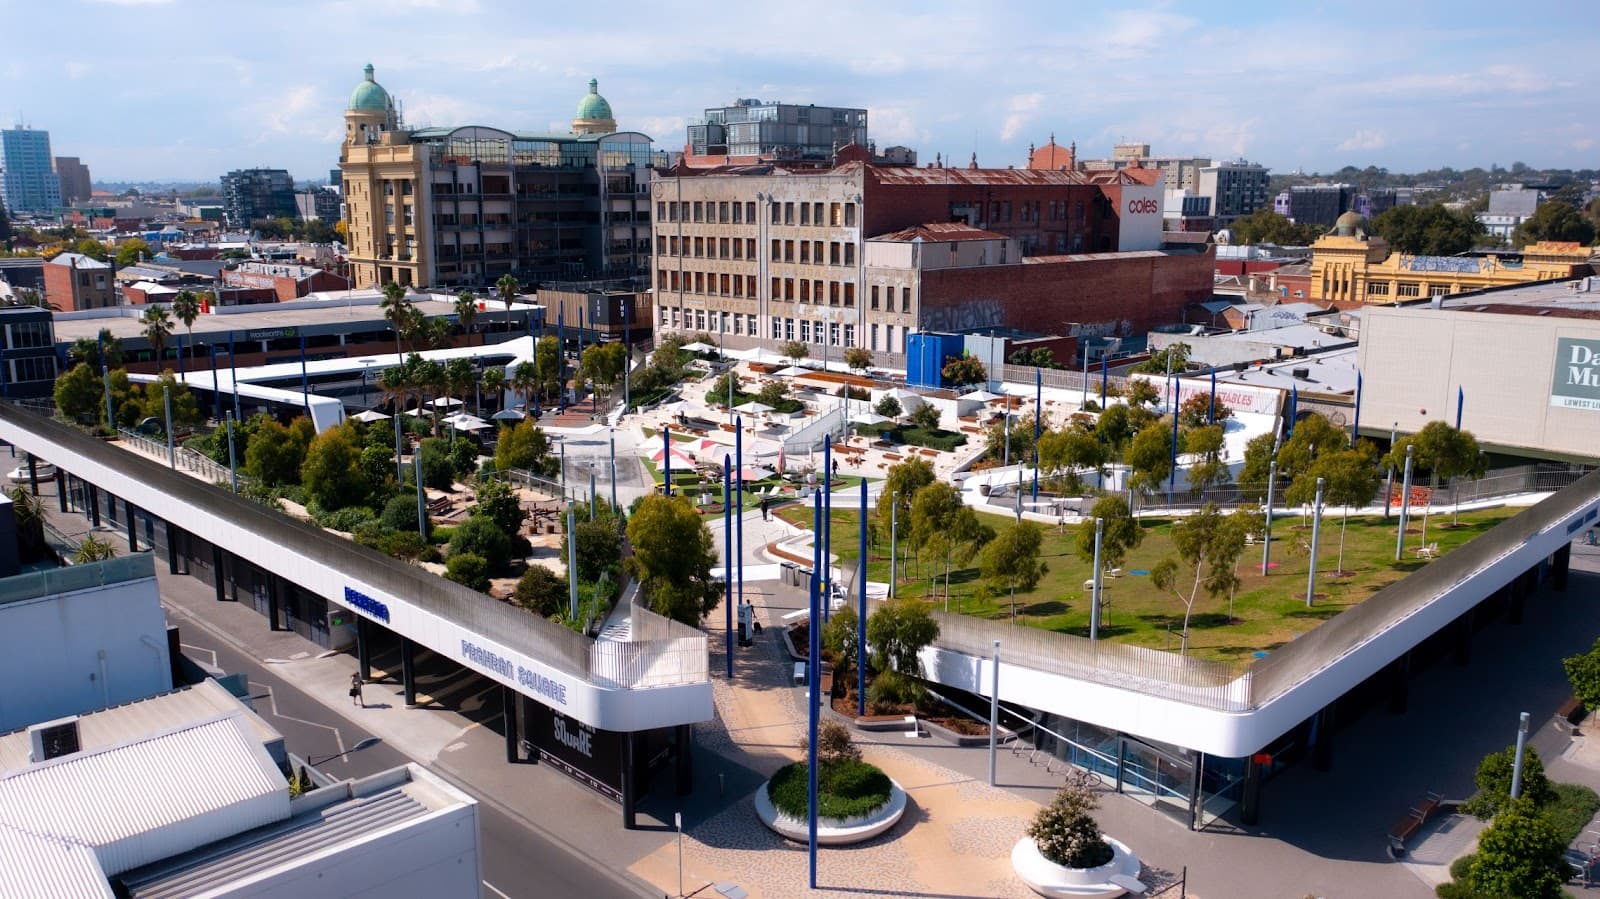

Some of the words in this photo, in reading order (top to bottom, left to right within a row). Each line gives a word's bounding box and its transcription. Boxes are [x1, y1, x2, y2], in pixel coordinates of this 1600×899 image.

[1129, 196, 1158, 214] coles
[1568, 344, 1600, 365] Da
[1566, 366, 1600, 387] Mu
[461, 639, 514, 681] PRAHRAN
[517, 666, 567, 706] SQUARE
